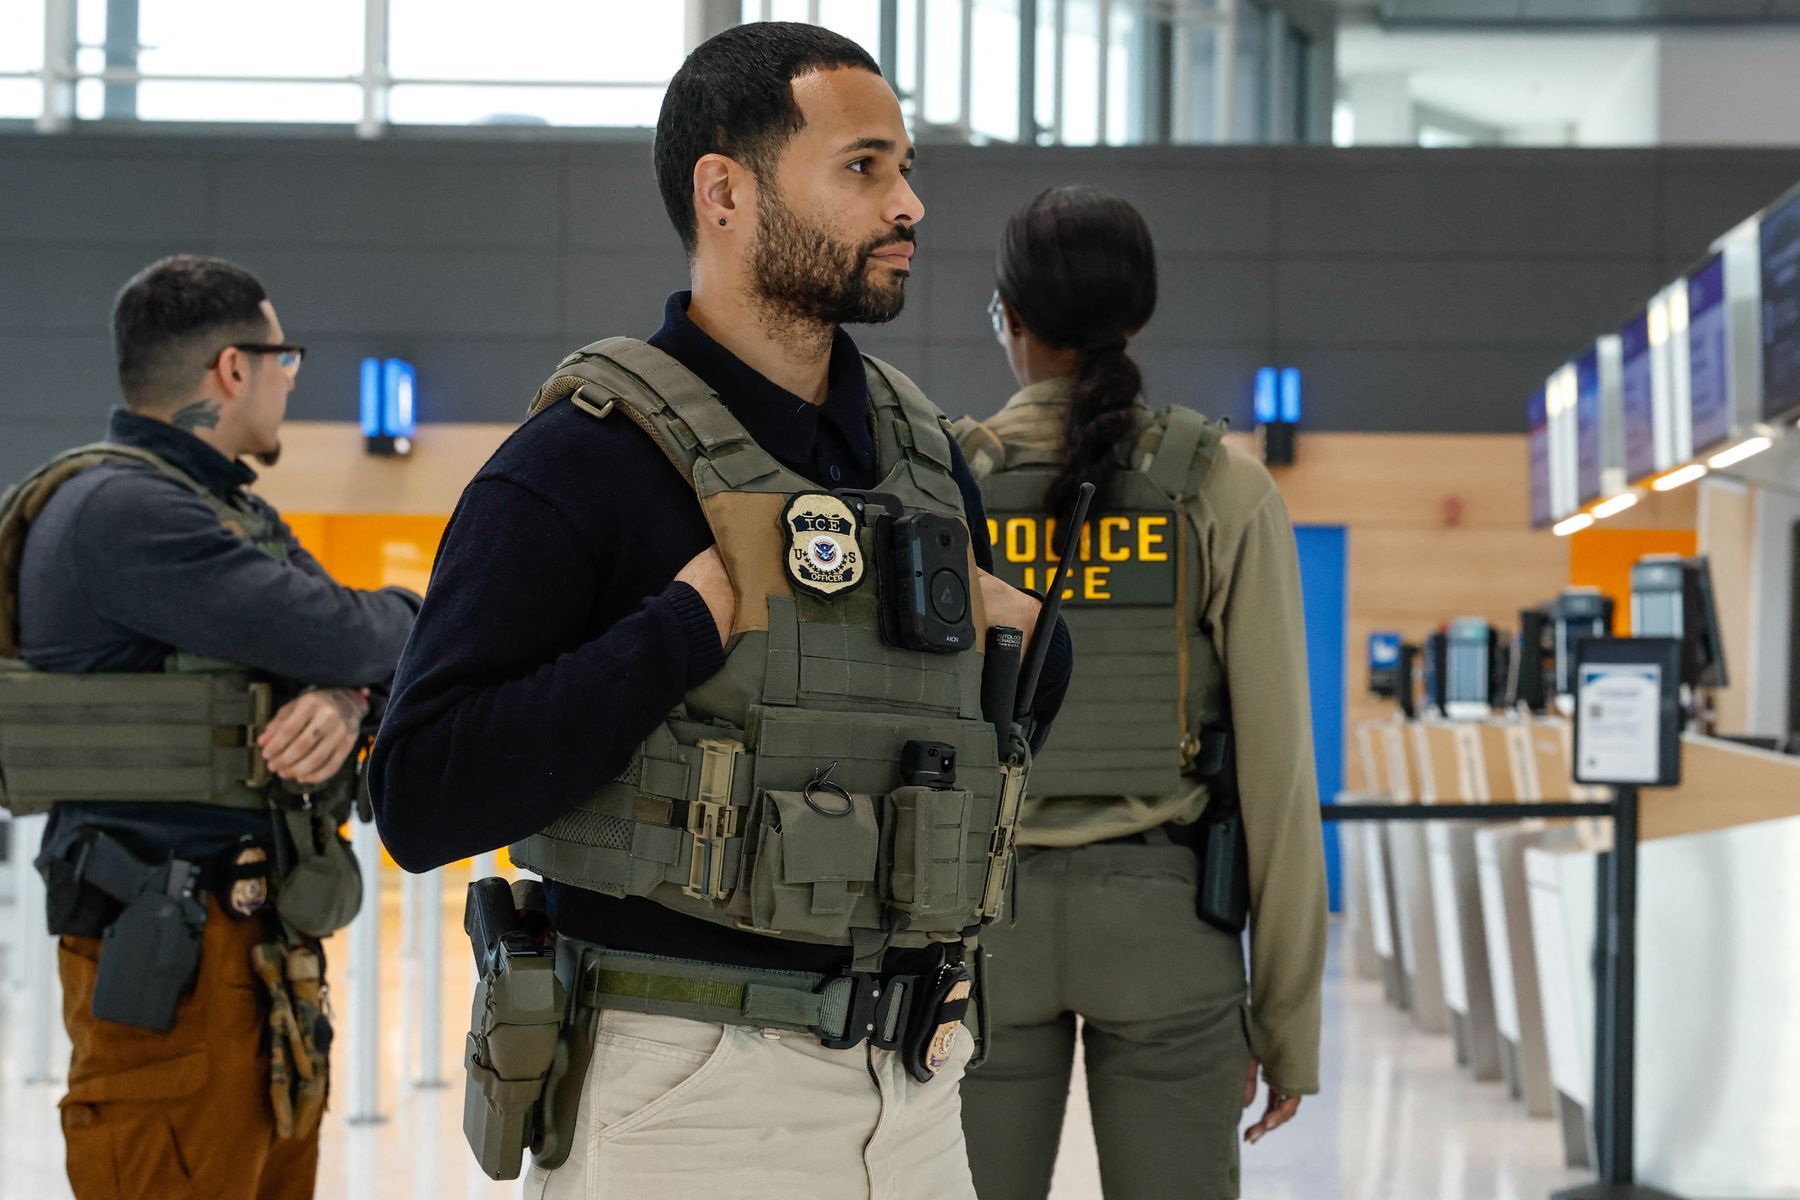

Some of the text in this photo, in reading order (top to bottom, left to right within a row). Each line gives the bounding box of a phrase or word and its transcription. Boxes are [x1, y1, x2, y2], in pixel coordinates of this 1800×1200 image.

[805, 519, 840, 531] ICE
[794, 549, 856, 563] U S
[811, 573, 843, 582] OFFICER
[1024, 566, 1111, 599] ICE
